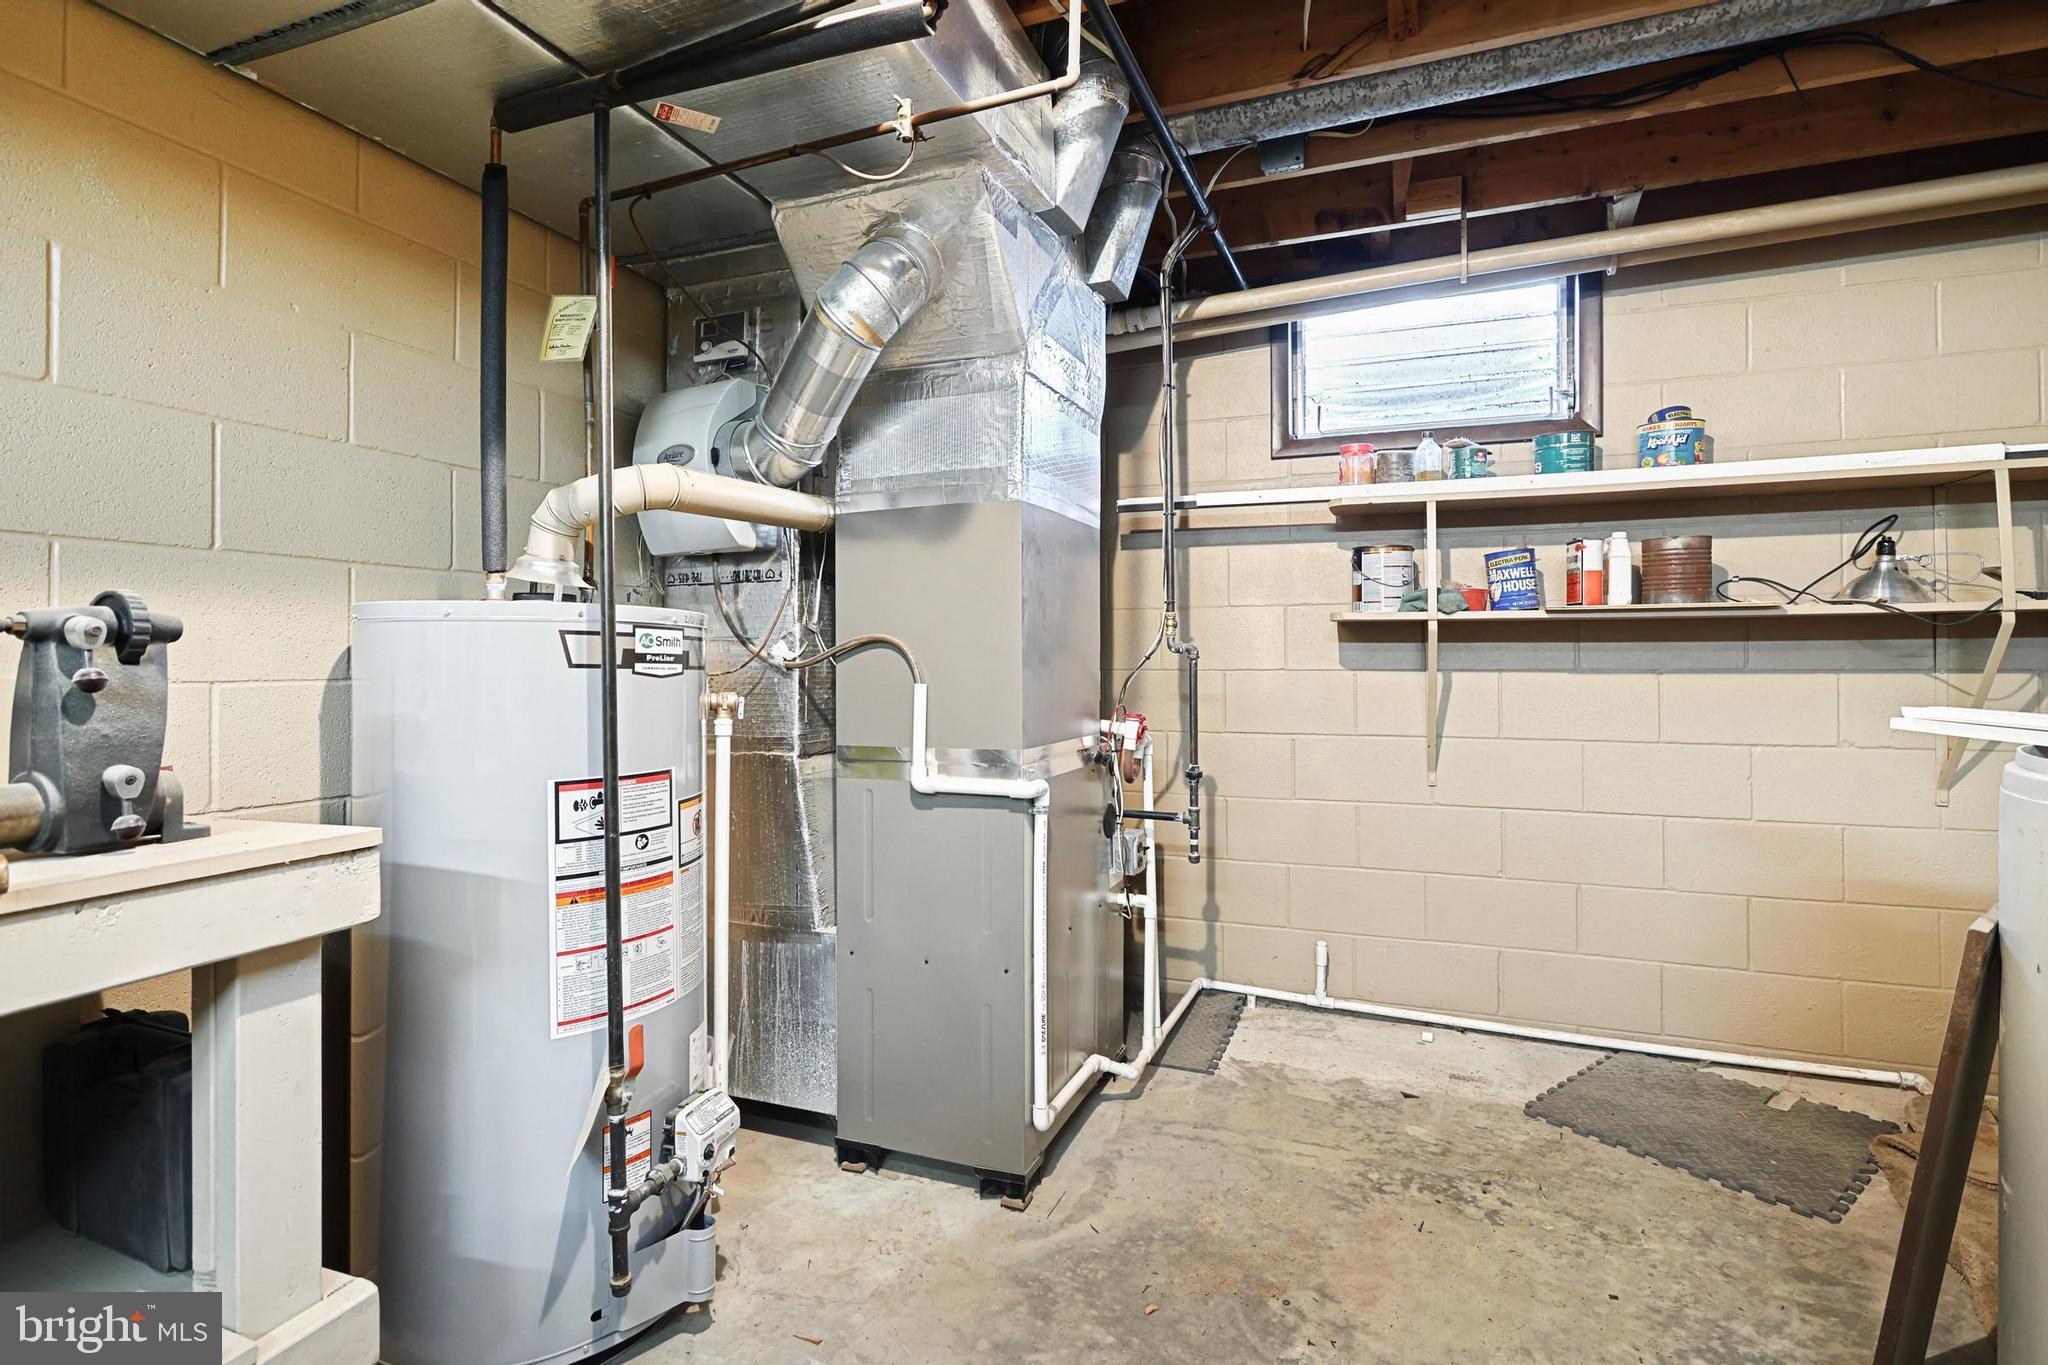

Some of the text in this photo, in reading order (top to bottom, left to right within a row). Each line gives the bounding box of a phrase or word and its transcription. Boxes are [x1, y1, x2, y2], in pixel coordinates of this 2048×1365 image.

[1647, 434, 1688, 449] Kool-Aid
[1489, 567, 1534, 582] MAXWELL
[1502, 579, 1536, 592] HOUSE
[655, 636, 681, 648] Smith
